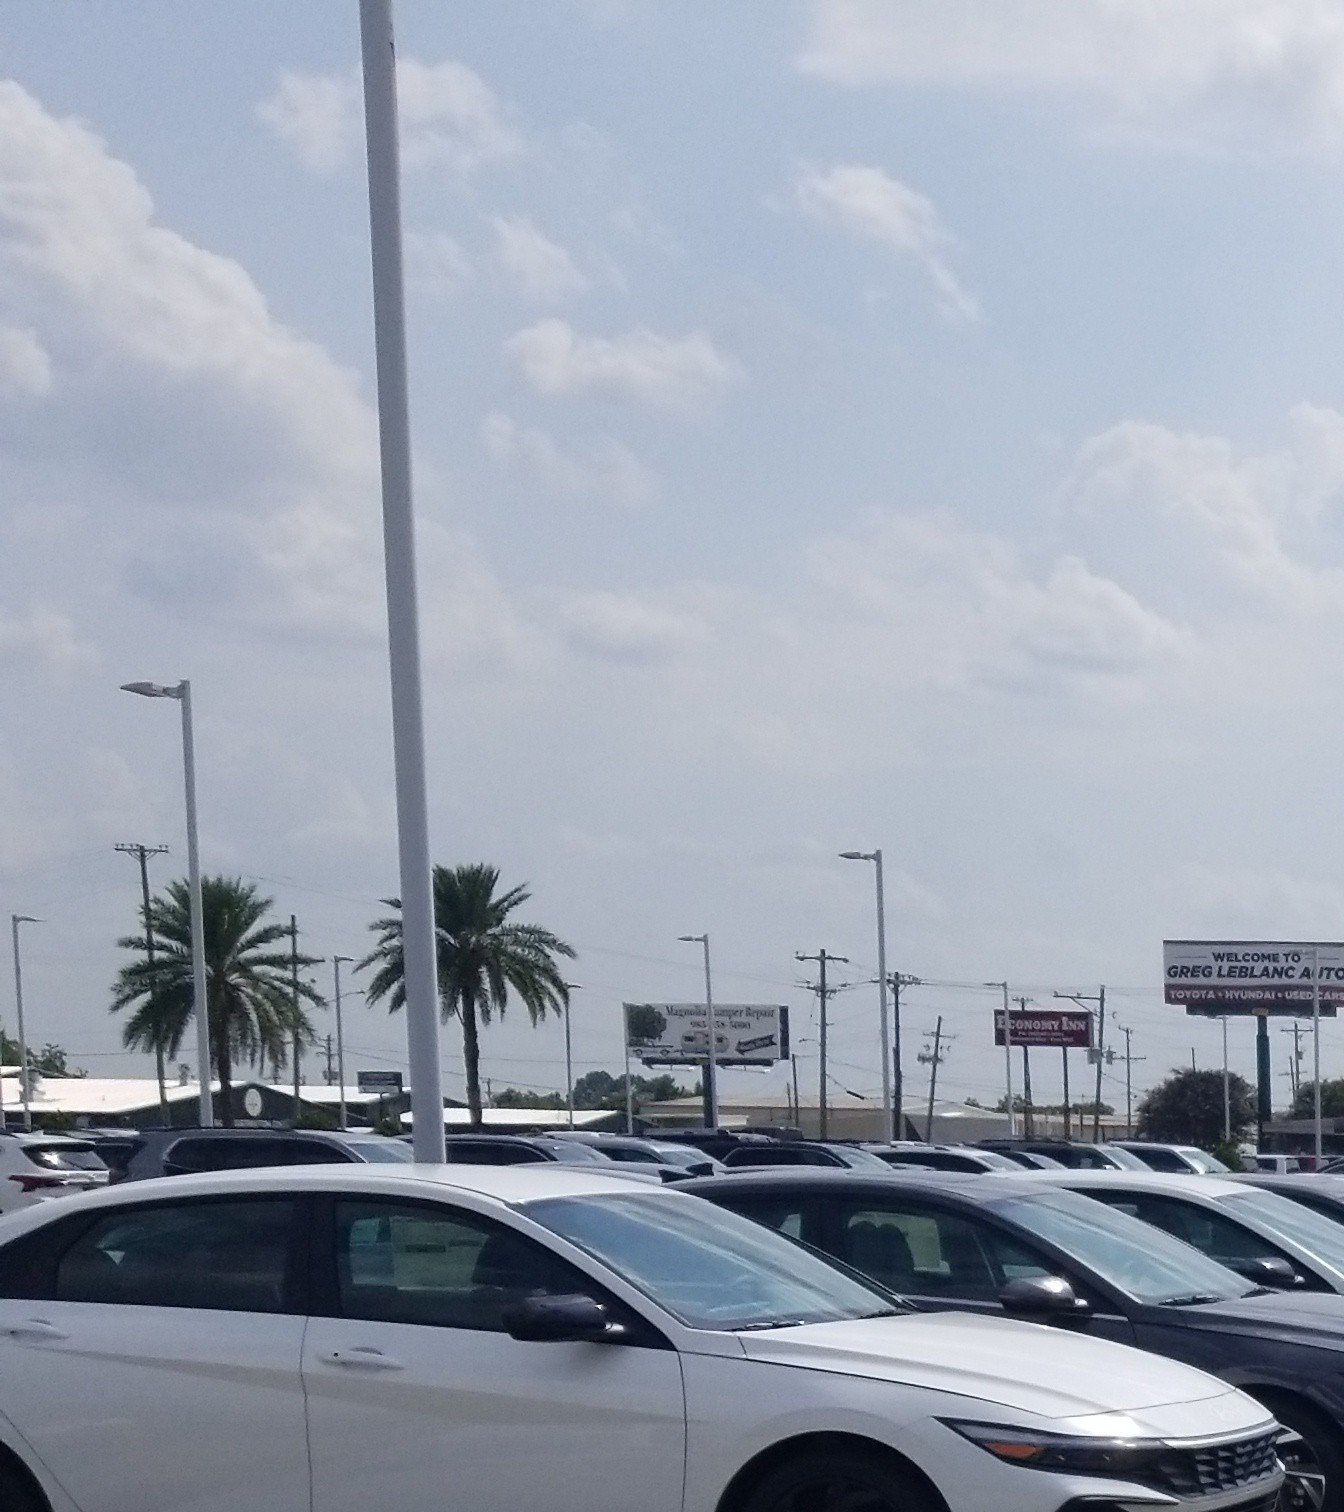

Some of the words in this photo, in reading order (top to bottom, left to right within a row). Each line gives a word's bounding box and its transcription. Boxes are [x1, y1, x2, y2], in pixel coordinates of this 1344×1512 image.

[1212, 952, 1280, 963] WELCOME
[1282, 953, 1301, 963] TO
[1167, 965, 1213, 979] GREG
[1216, 965, 1296, 980] LEBLANC
[1169, 990, 1216, 999] TOYOTA
[1225, 990, 1277, 1000] HYUNDAI
[1285, 991, 1314, 1000] USED
[712, 1006, 744, 1021] amper
